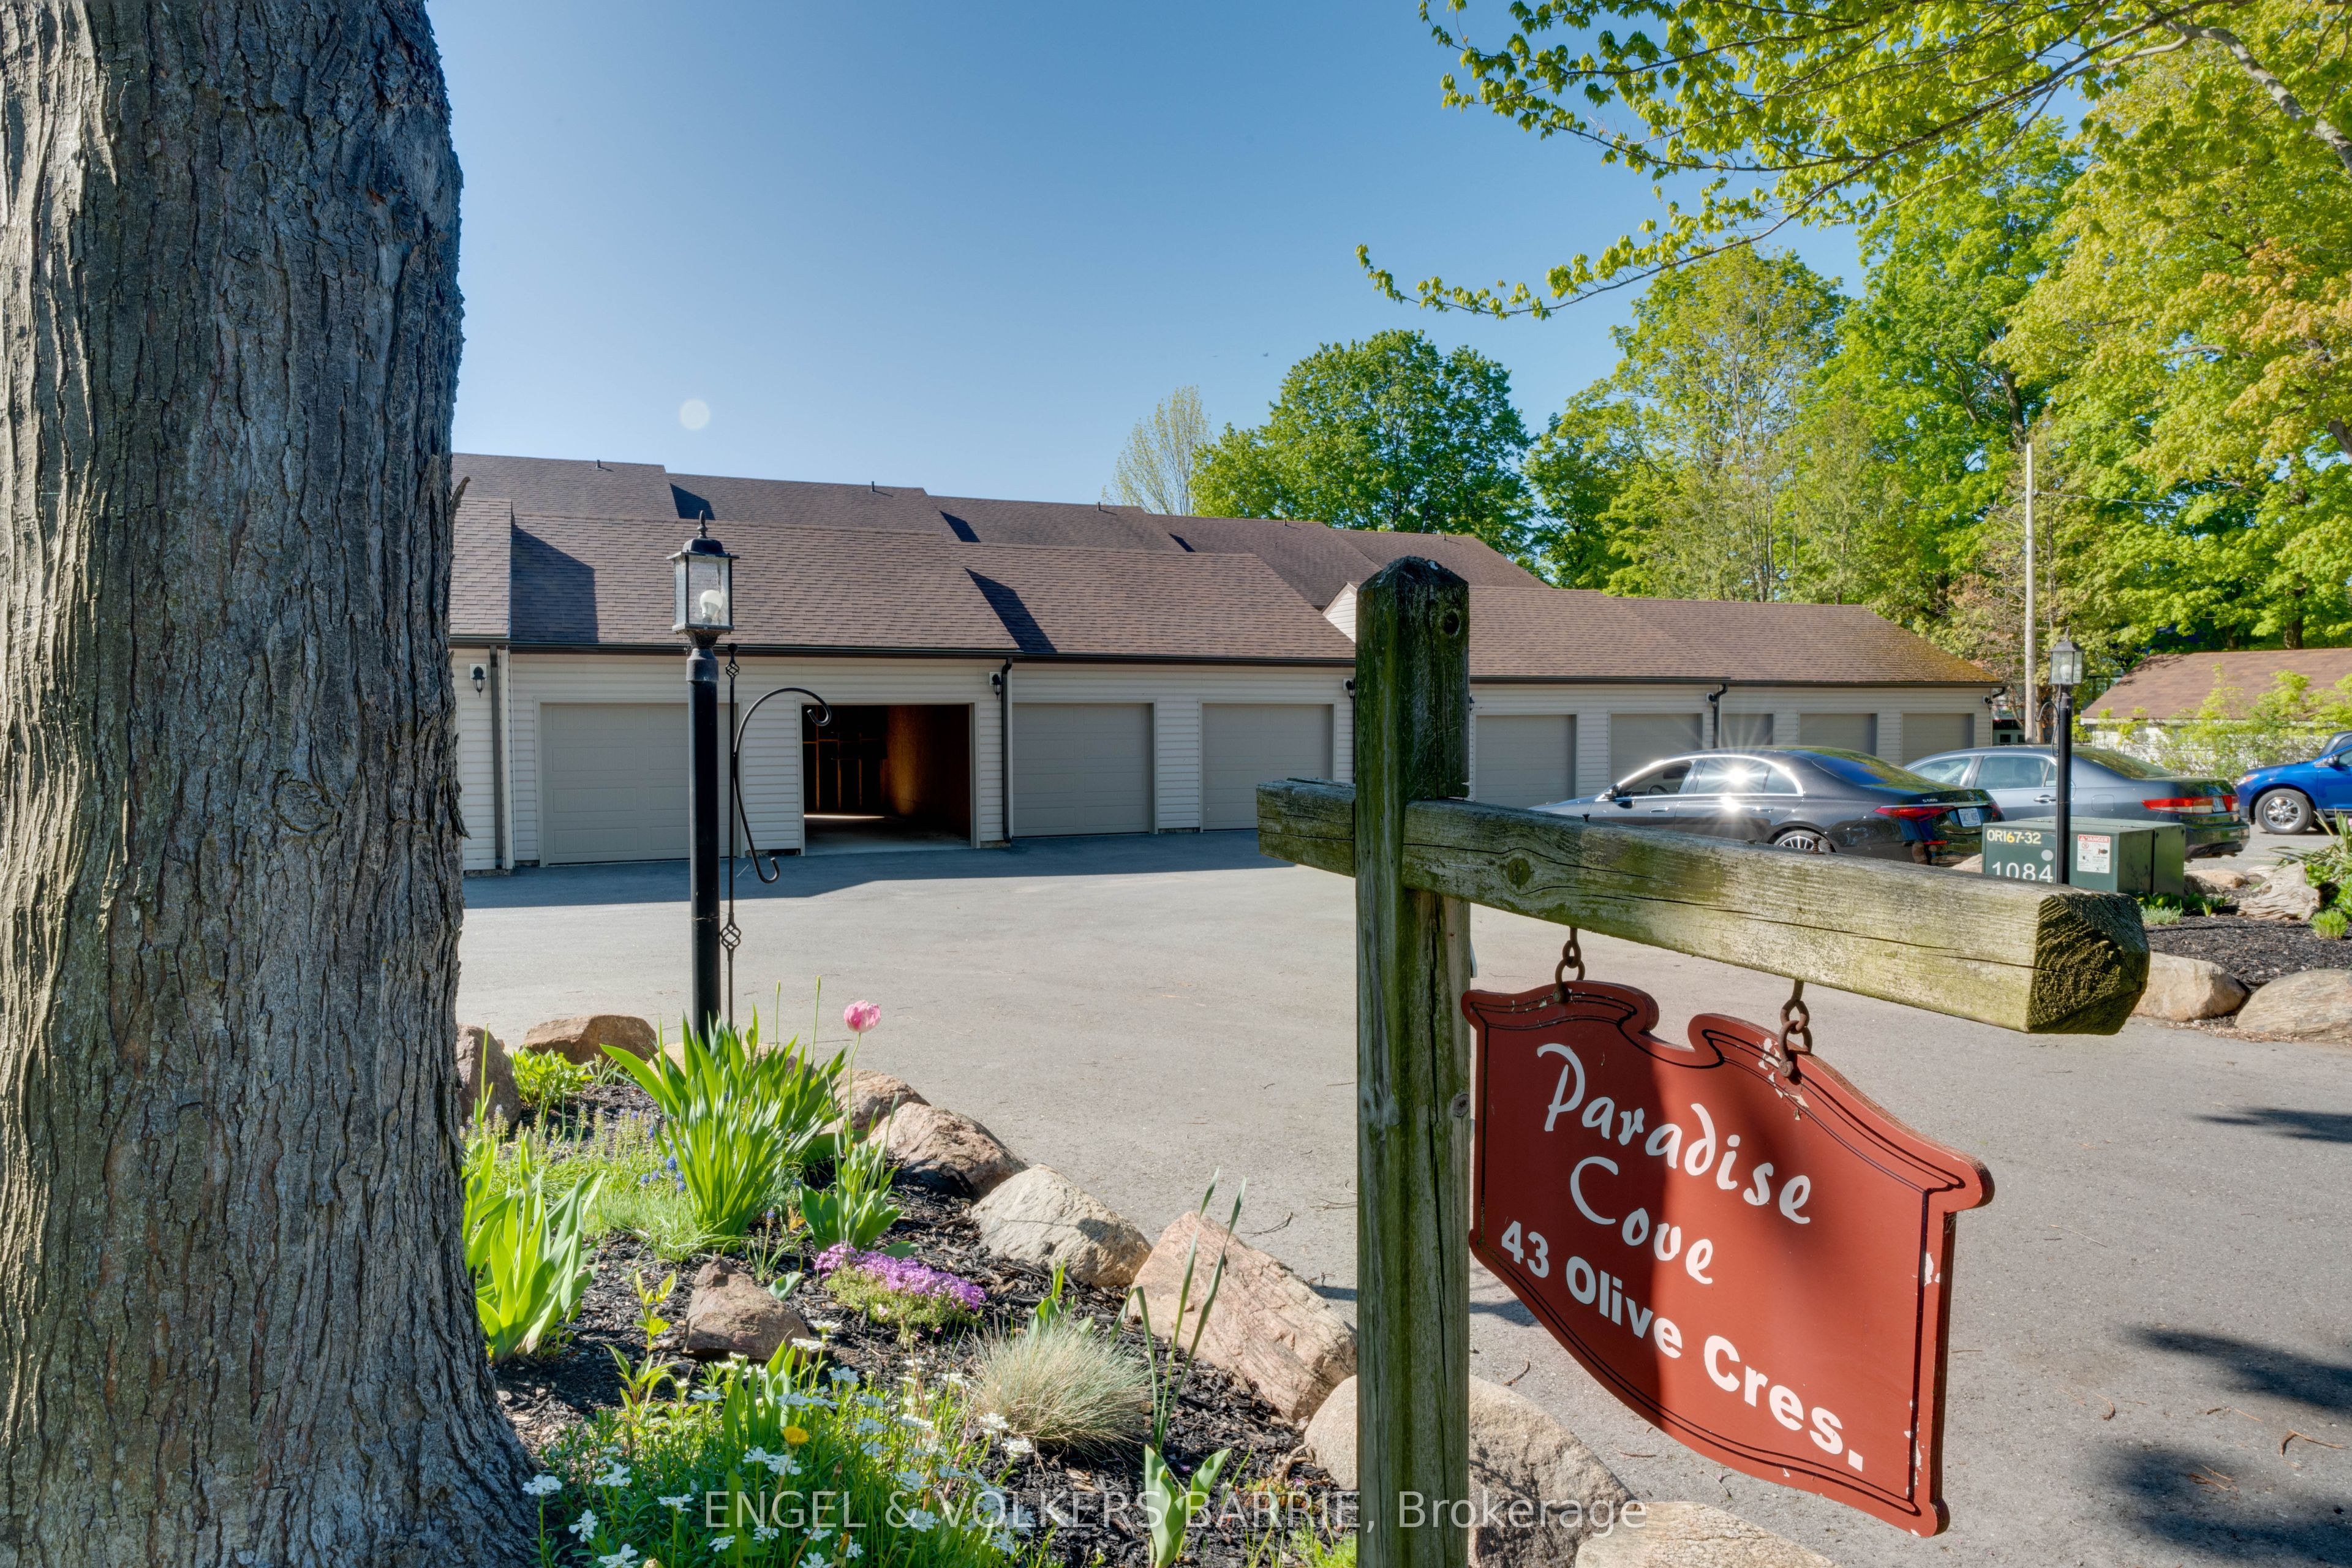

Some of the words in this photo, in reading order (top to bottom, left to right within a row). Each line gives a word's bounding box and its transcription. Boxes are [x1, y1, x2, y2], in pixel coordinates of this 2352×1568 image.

[1992, 861, 2054, 883] 1084
[1537, 1042, 1811, 1224] Paradise
[1570, 1156, 1714, 1285] Cove
[1501, 1220, 1550, 1278] 43
[1566, 1256, 1683, 1359] Olive
[1703, 1334, 1864, 1472] Cres.
